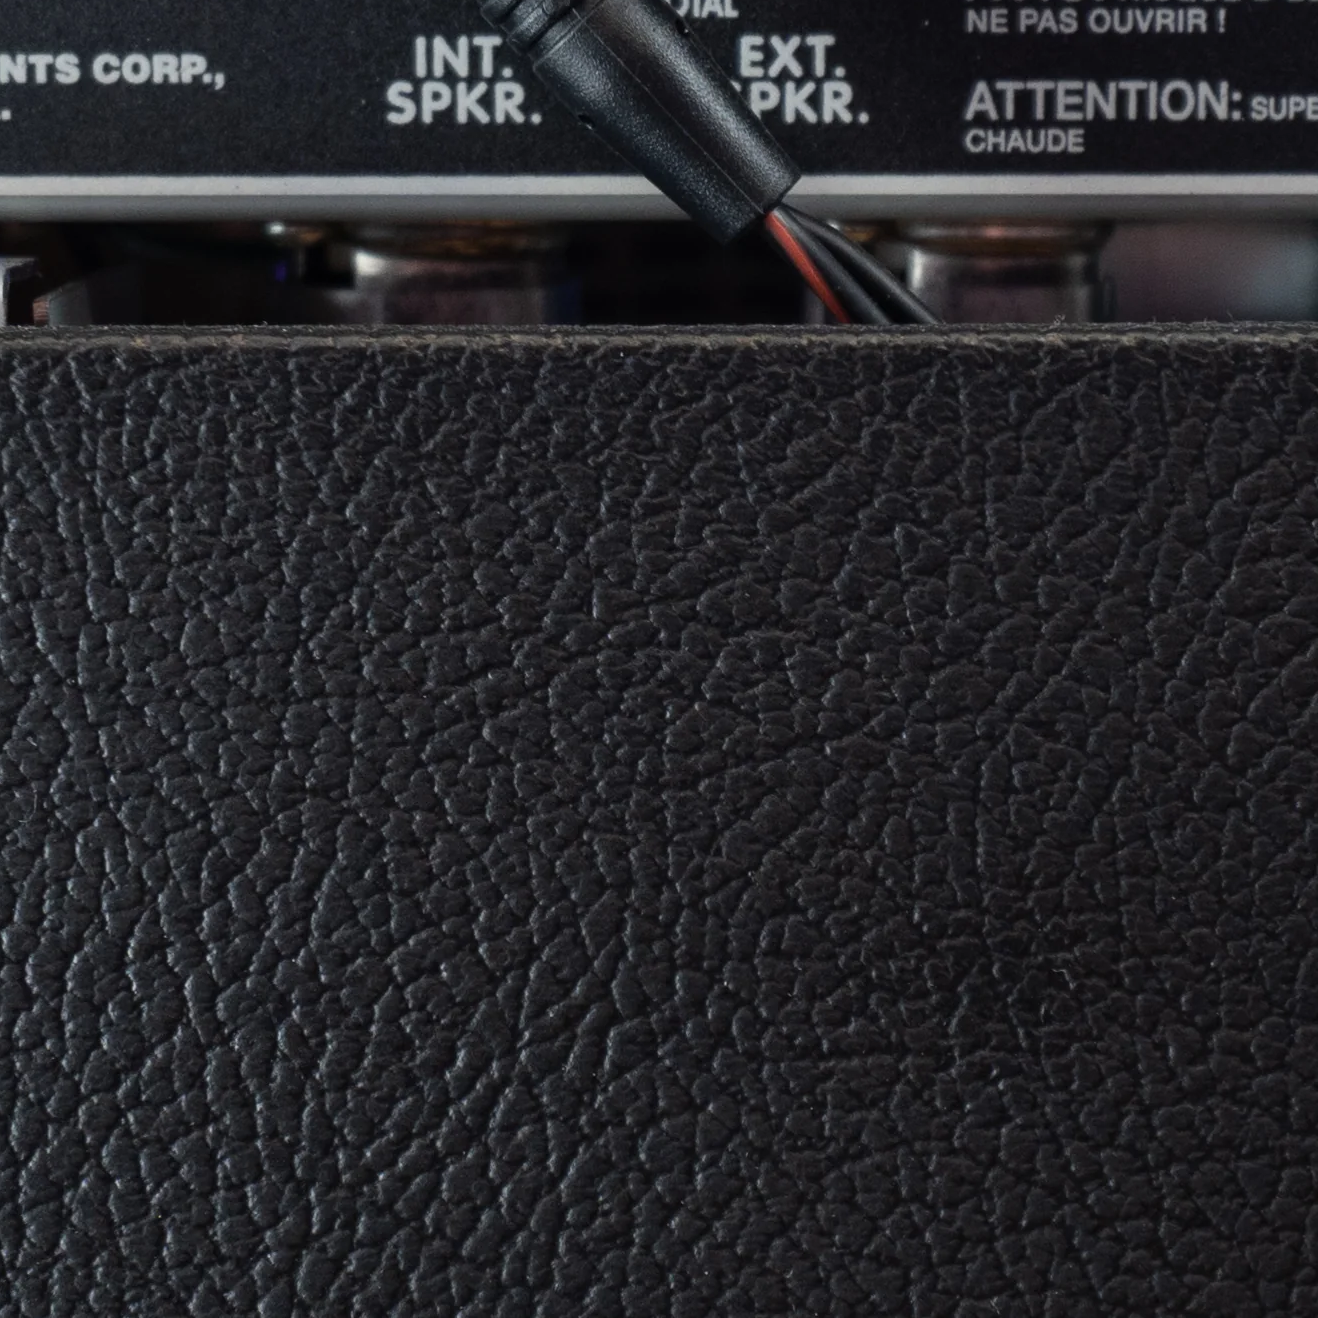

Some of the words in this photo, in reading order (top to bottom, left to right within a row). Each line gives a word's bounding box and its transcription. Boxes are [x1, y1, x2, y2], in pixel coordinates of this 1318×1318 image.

[966, 7, 1009, 34] NE
[1018, 7, 1079, 35] PAS
[1087, 7, 1208, 34] OUVRIR
[91, 52, 225, 91] CORP.,
[414, 34, 513, 79] INT.
[738, 34, 846, 79] EXT.
[385, 80, 542, 125] SPKR.
[733, 80, 870, 126] PKR.
[964, 79, 1242, 122] ATTENTION:
[963, 127, 1085, 154] CHAUDE
